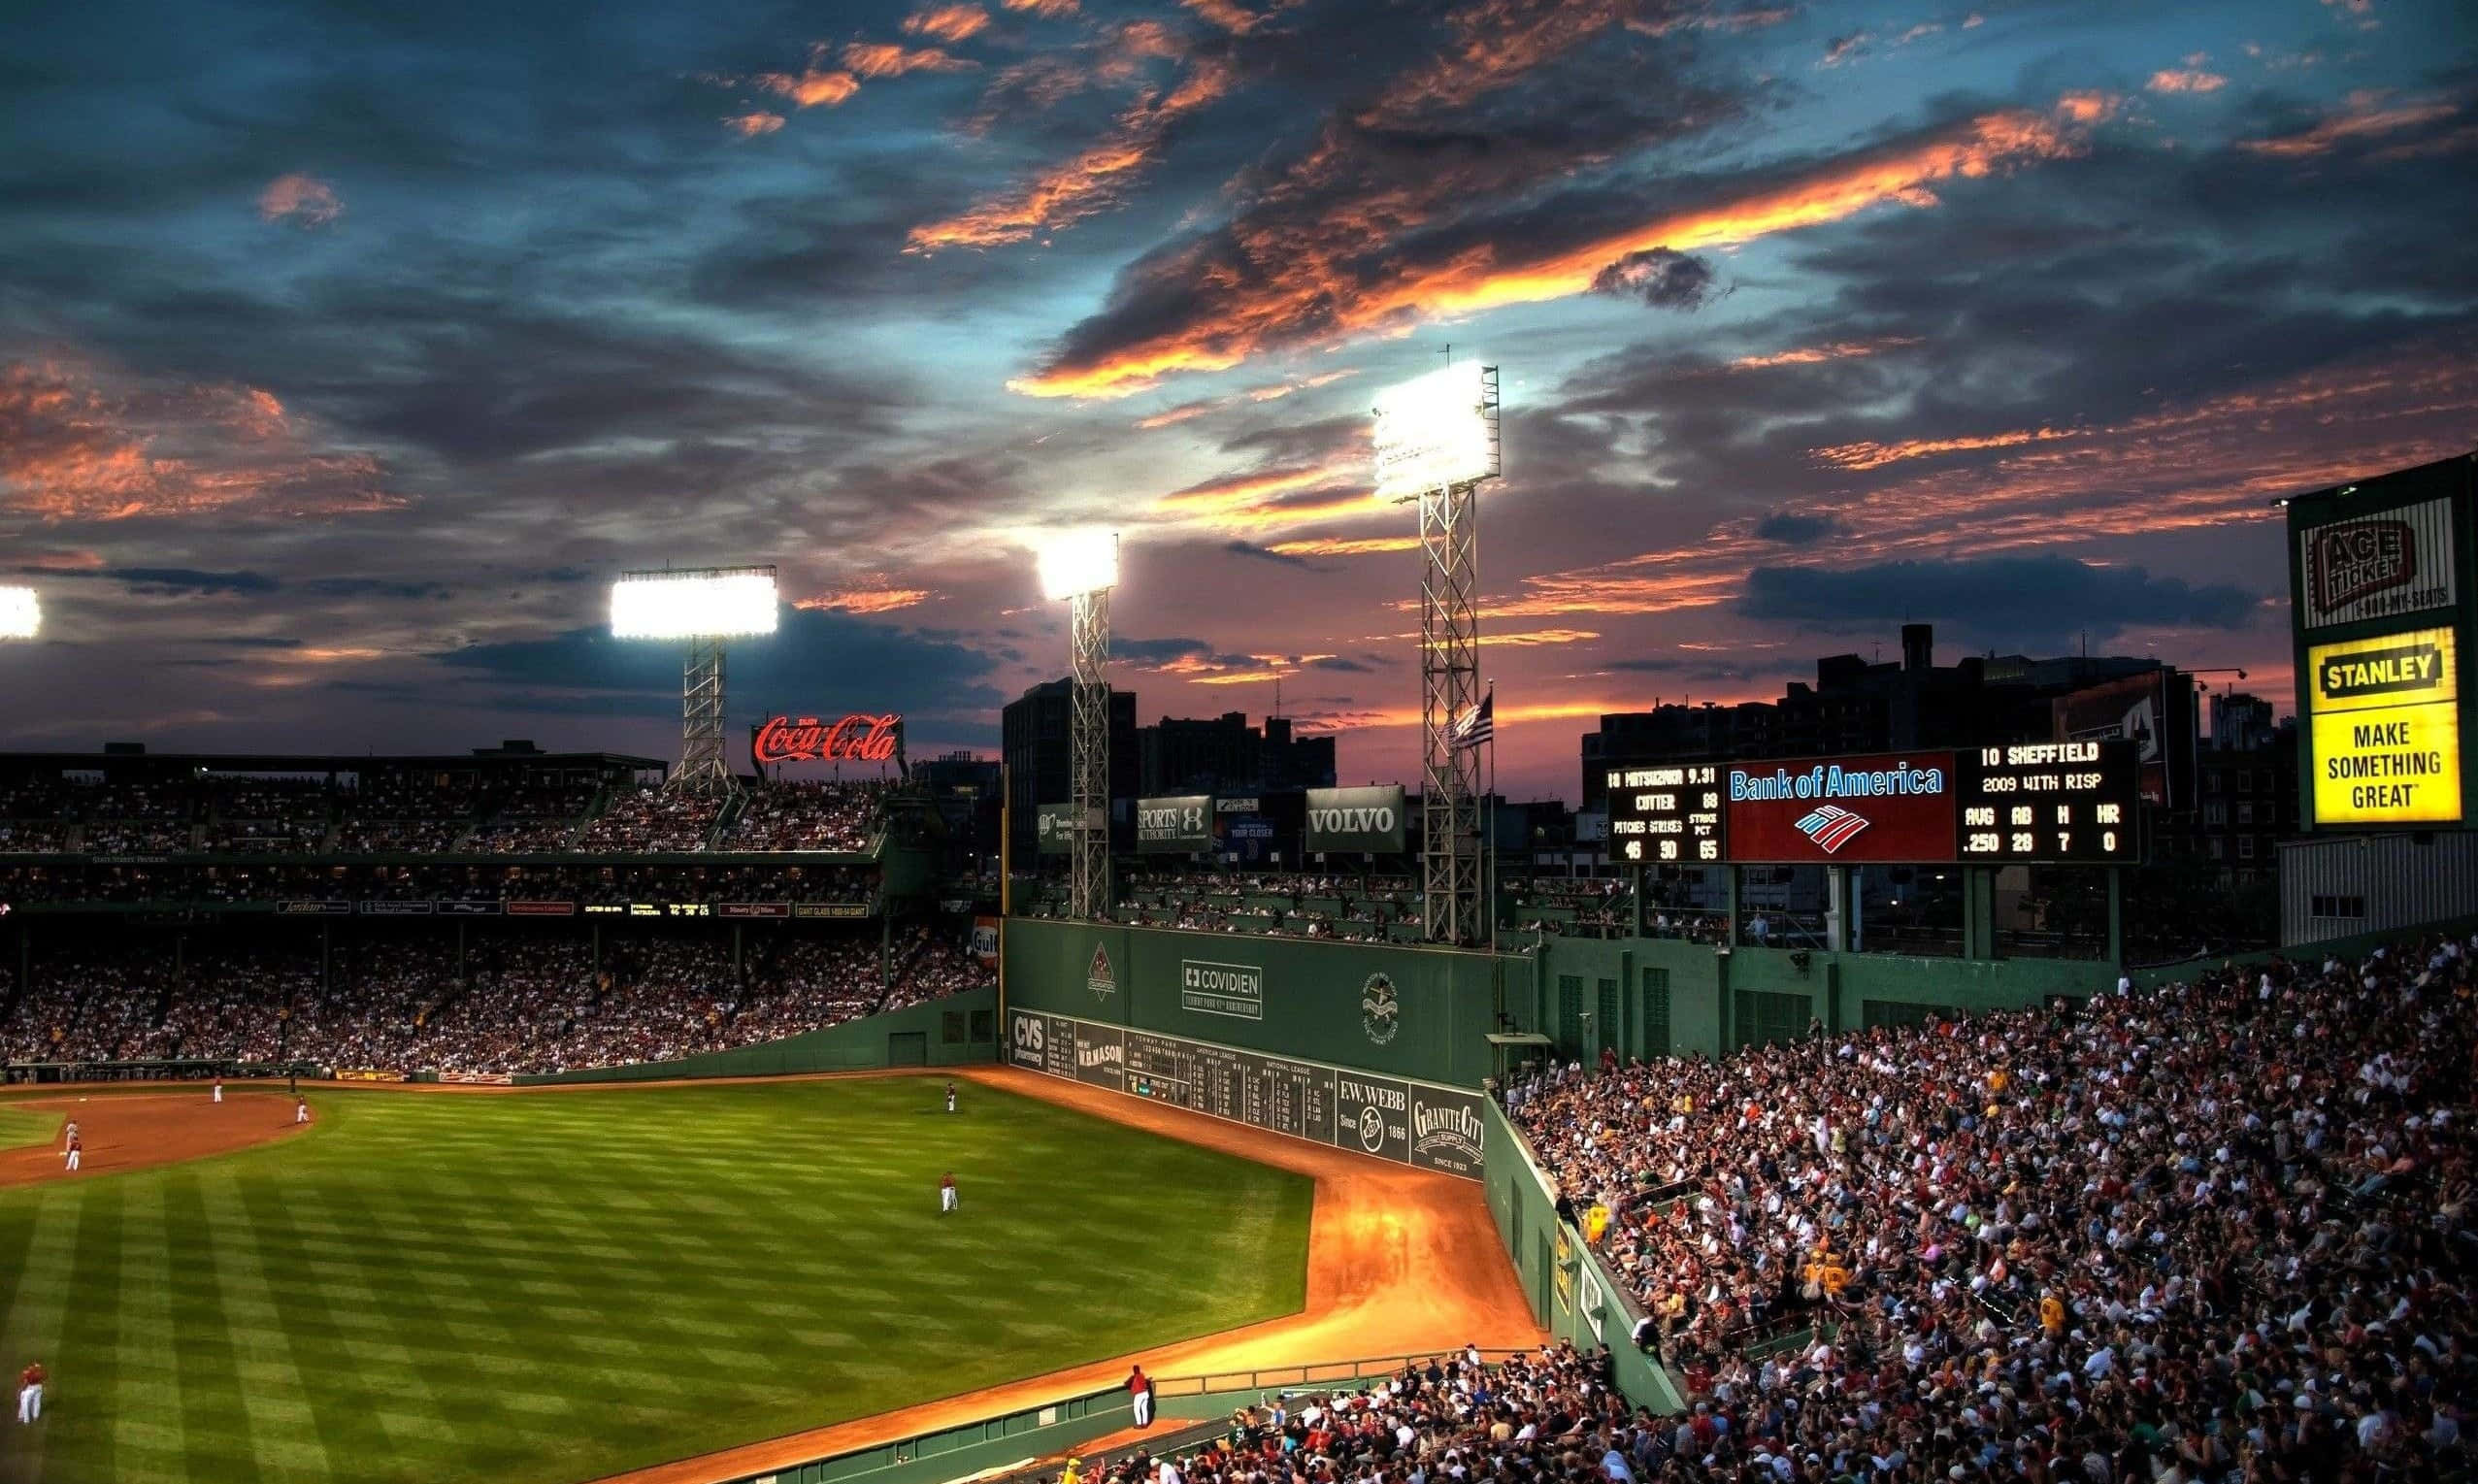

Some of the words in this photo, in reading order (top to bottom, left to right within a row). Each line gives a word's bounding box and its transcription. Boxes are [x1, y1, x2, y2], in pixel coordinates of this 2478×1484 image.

[2329, 529, 2401, 565] ACE
[2330, 560, 2401, 599] TICKET
[2328, 653, 2433, 690] STANLEY
[755, 714, 902, 762] Coca-Cola
[2354, 722, 2411, 748] MAKE
[1982, 747, 1999, 767] 10
[2007, 742, 2099, 766] SHEFFIELD
[2328, 751, 2442, 780] SOMETHING
[1731, 768, 1793, 802] Bank
[1795, 765, 1824, 799] of
[1825, 761, 1943, 798] America
[1983, 776, 2017, 793] 2009
[2065, 773, 2102, 790] RISP
[1635, 794, 1675, 810] CUTTER
[1138, 808, 1177, 829] SPORTS
[1307, 808, 1395, 834] VOLVO
[1966, 807, 1996, 826] AVG
[2011, 806, 2033, 825] AB
[2057, 805, 2070, 825] H
[2097, 804, 2120, 824] HR
[1139, 828, 1177, 841] AUTHORITY
[1695, 826, 1712, 836] PCT
[1964, 833, 1999, 852] .250
[2012, 832, 2033, 852] 28
[2058, 832, 2070, 852] 7
[2102, 831, 2117, 852] 0
[1626, 840, 1642, 860] 46
[1660, 840, 1677, 860] 30
[1700, 840, 1717, 860] 65
[1202, 970, 1259, 995] COVIDIEN
[1014, 1015, 1043, 1050] CVS
[1366, 1086, 1405, 1111] WEBB
[1339, 1113, 1358, 1129] Since
[1388, 1125, 1406, 1140] 1866
[1414, 1100, 1461, 1138] GRANITE
